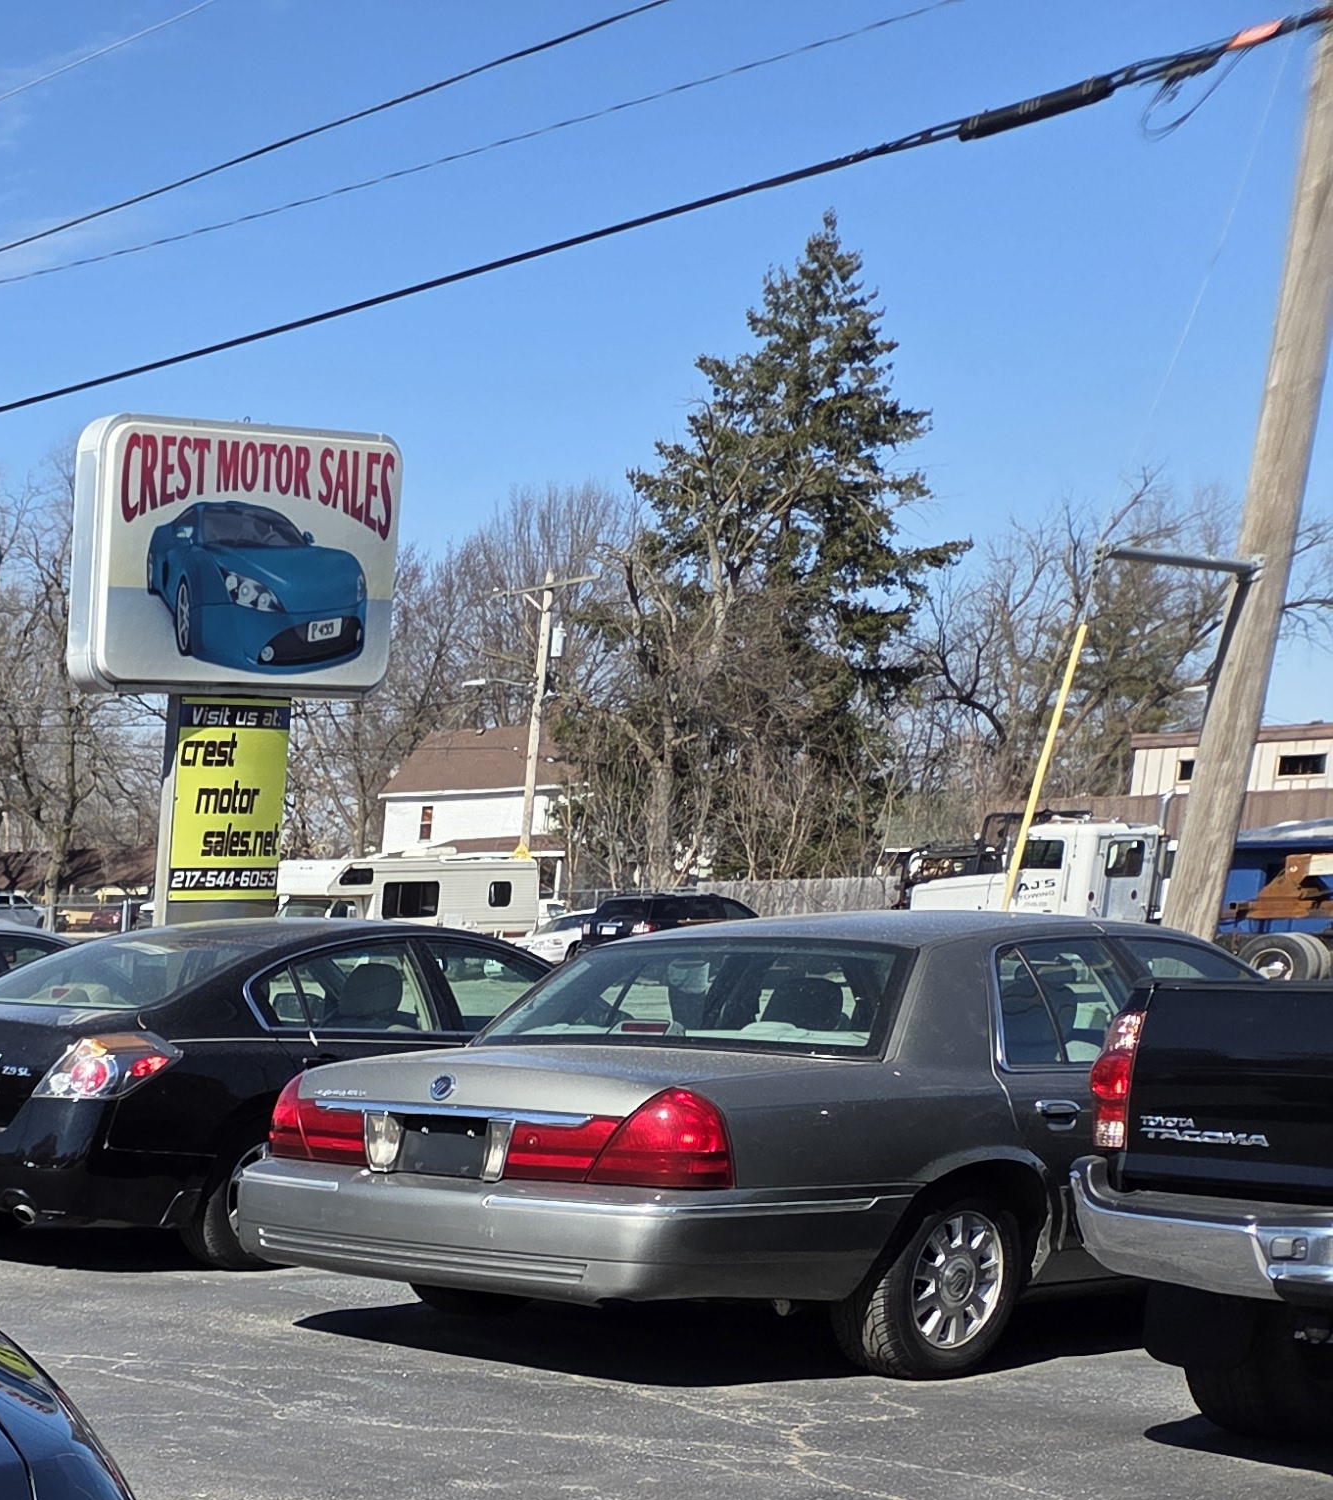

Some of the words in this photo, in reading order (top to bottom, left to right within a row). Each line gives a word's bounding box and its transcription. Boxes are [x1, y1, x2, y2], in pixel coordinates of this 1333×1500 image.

[121, 432, 211, 523] CREST
[216, 439, 311, 499] MOTOR
[318, 447, 395, 541] SALES
[192, 706, 230, 726] Visit
[235, 710, 258, 726] us
[262, 708, 281, 727] at:
[180, 732, 237, 767] crest
[195, 780, 260, 814] motor
[201, 822, 280, 857] sales.net
[171, 871, 276, 888] 217-544-6053
[1140, 1115, 1195, 1128] TOYOTA
[1140, 1127, 1270, 1147] TACOMA
